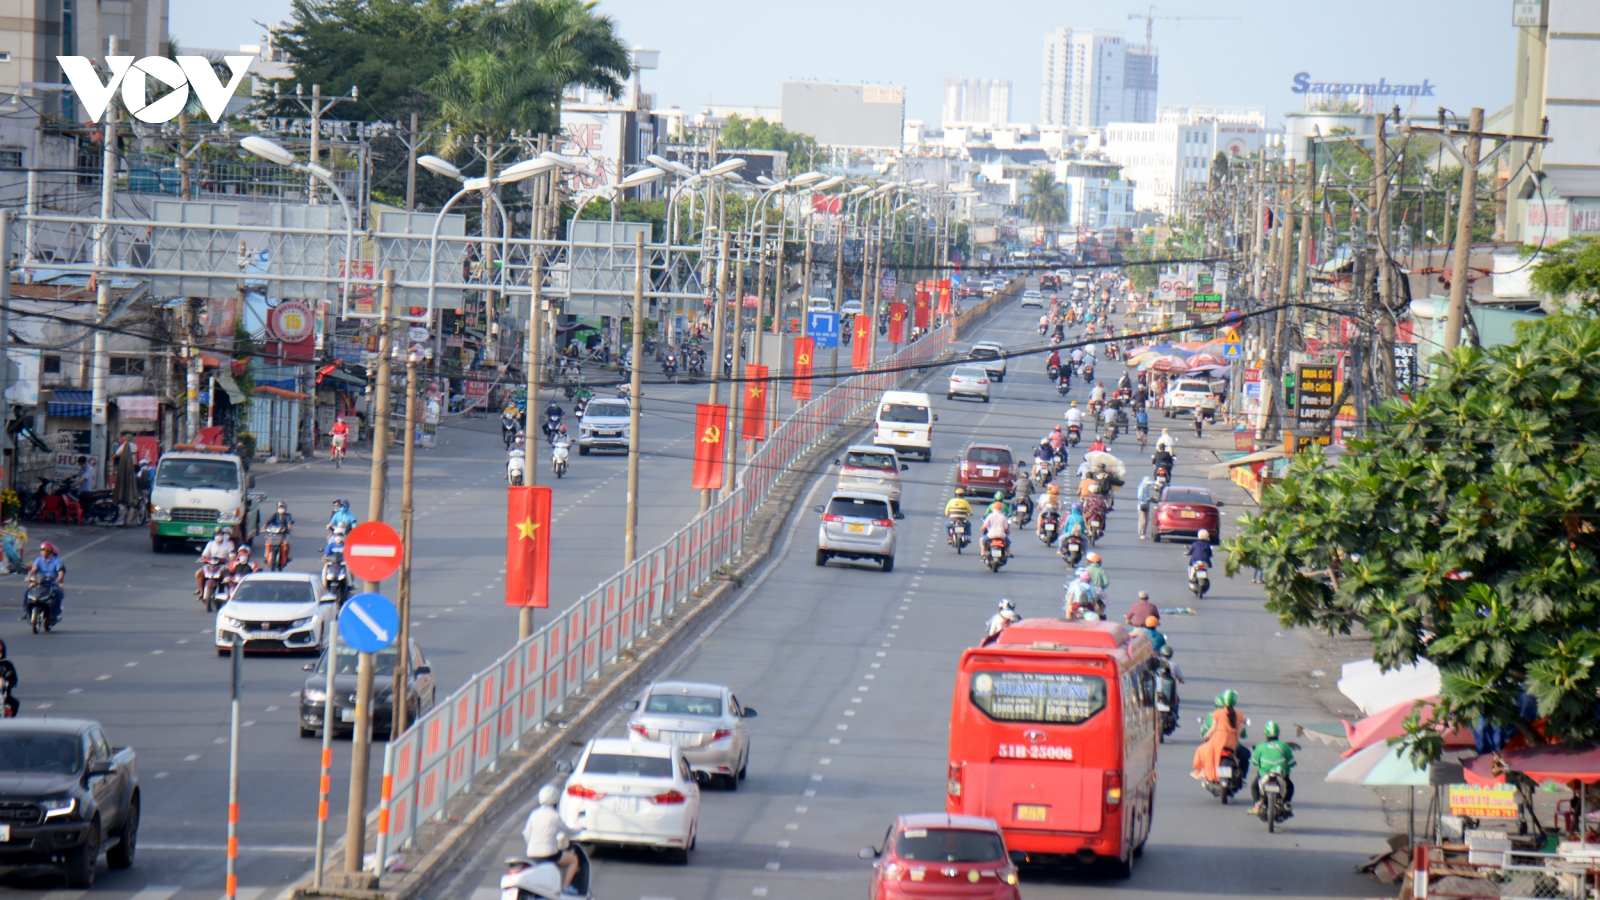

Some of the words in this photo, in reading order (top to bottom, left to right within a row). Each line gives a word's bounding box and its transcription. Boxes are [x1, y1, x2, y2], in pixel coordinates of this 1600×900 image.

[1291, 72, 1436, 96] Sacombank
[568, 123, 602, 150] XE
[284, 313, 301, 330] 15
[1302, 369, 1317, 378] MUA
[470, 381, 484, 389] KEM
[994, 680, 1046, 697] THÀNH
[1049, 682, 1089, 699] CÔNG
[999, 743, 1073, 760] 51B-25006
[1452, 794, 1475, 805] REMOTE
